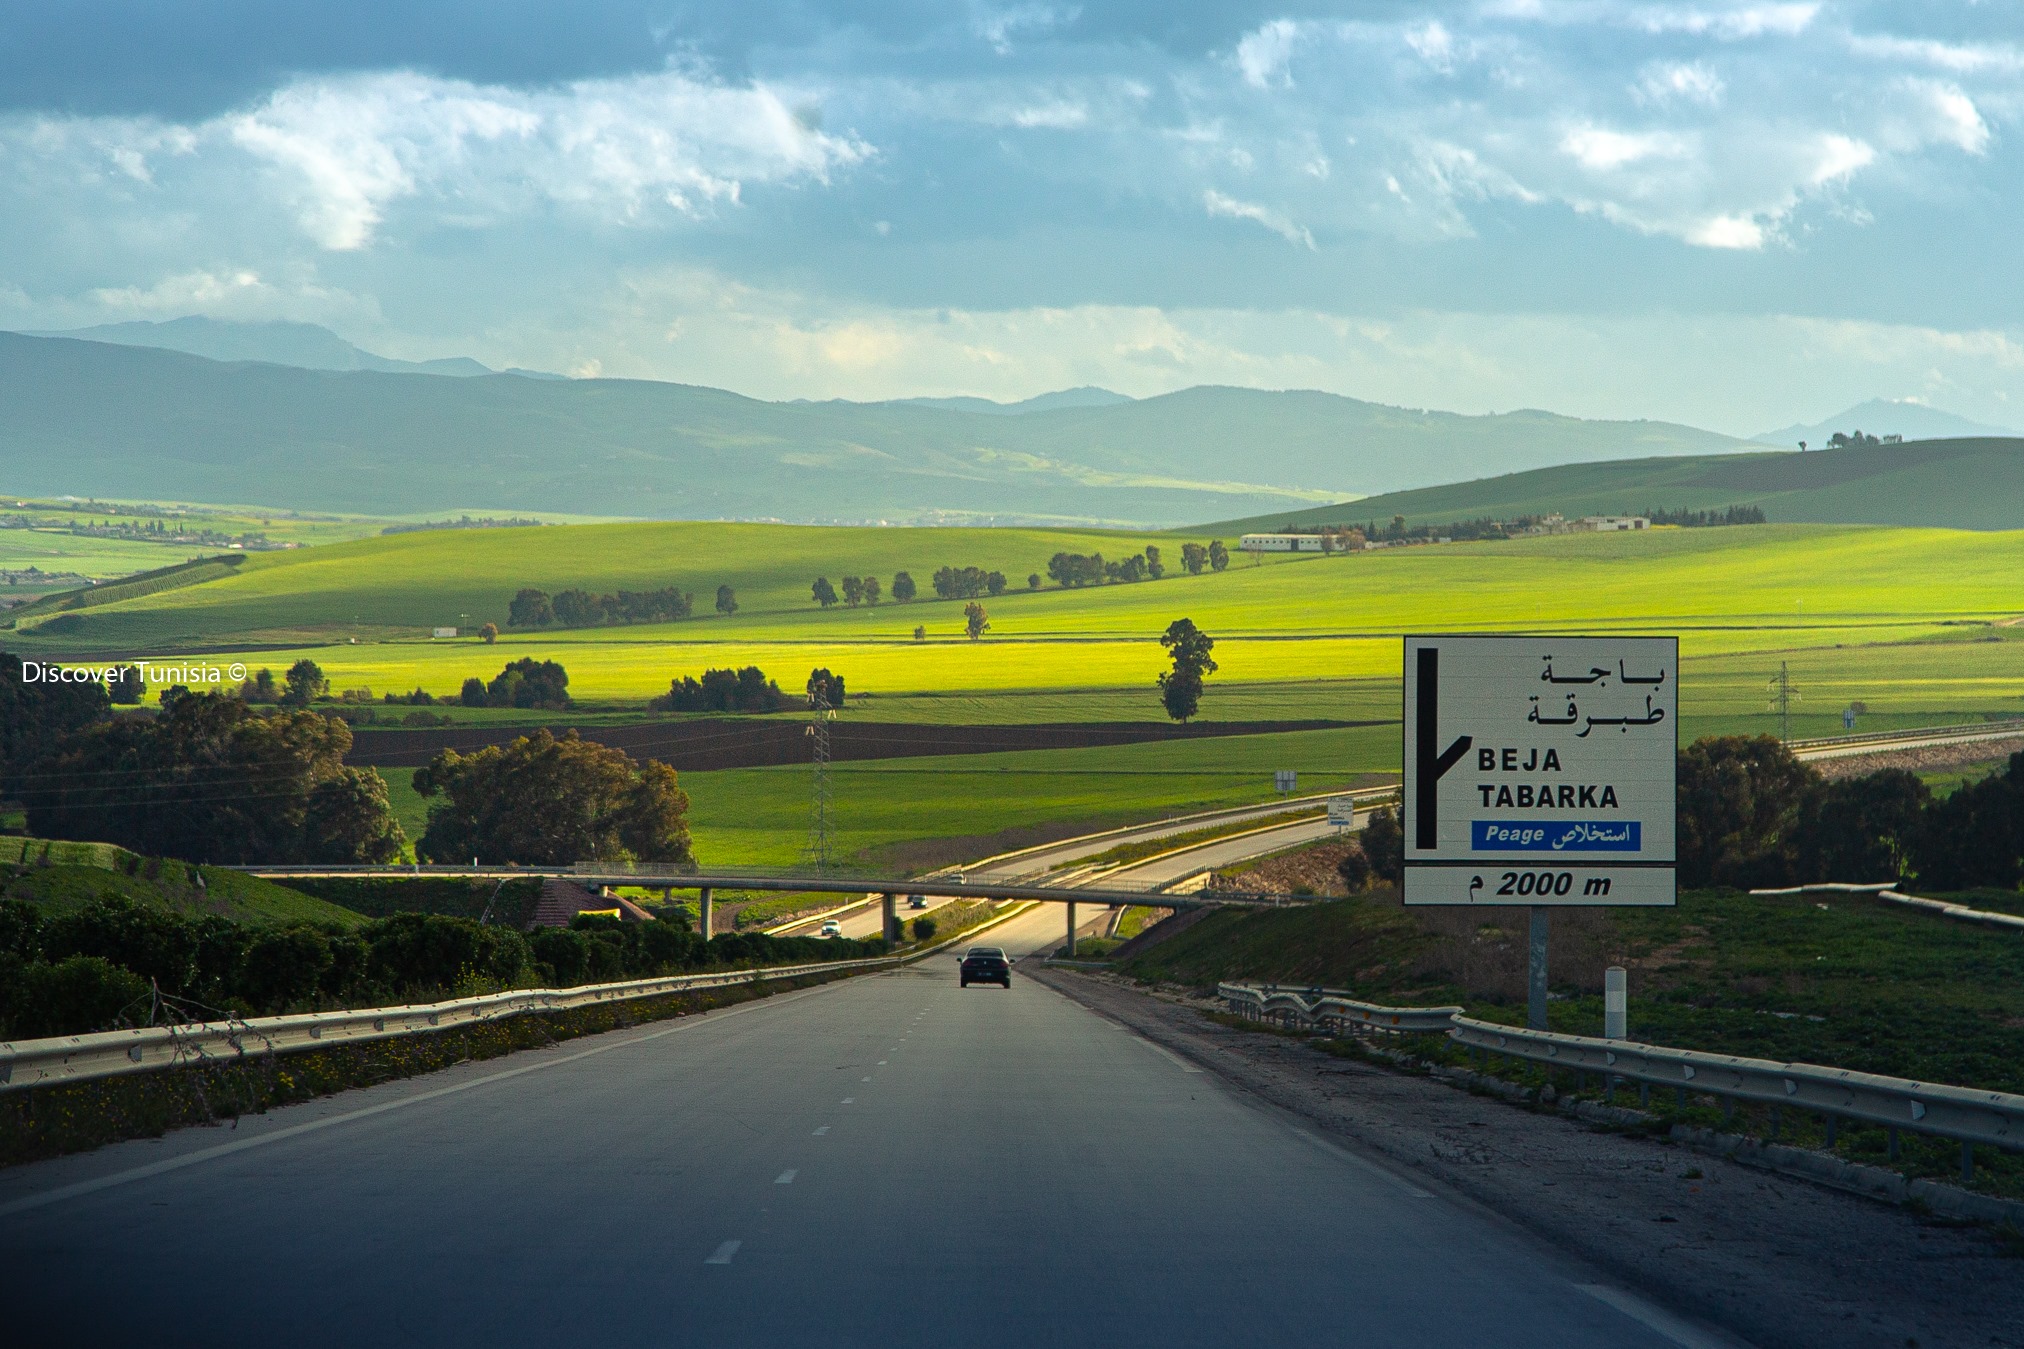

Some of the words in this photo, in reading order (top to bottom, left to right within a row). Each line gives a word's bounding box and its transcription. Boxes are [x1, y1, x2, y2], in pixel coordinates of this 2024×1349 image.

[1541, 654, 1665, 692] باجة
[1527, 692, 1665, 738] طبرقة
[1478, 748, 1562, 772] BEJA
[1477, 784, 1619, 809] TABARKA
[1485, 825, 1545, 844] Peage
[1552, 823, 1631, 850] استخلاص
[1496, 871, 1574, 897] 2000
[1583, 877, 1612, 896] m
